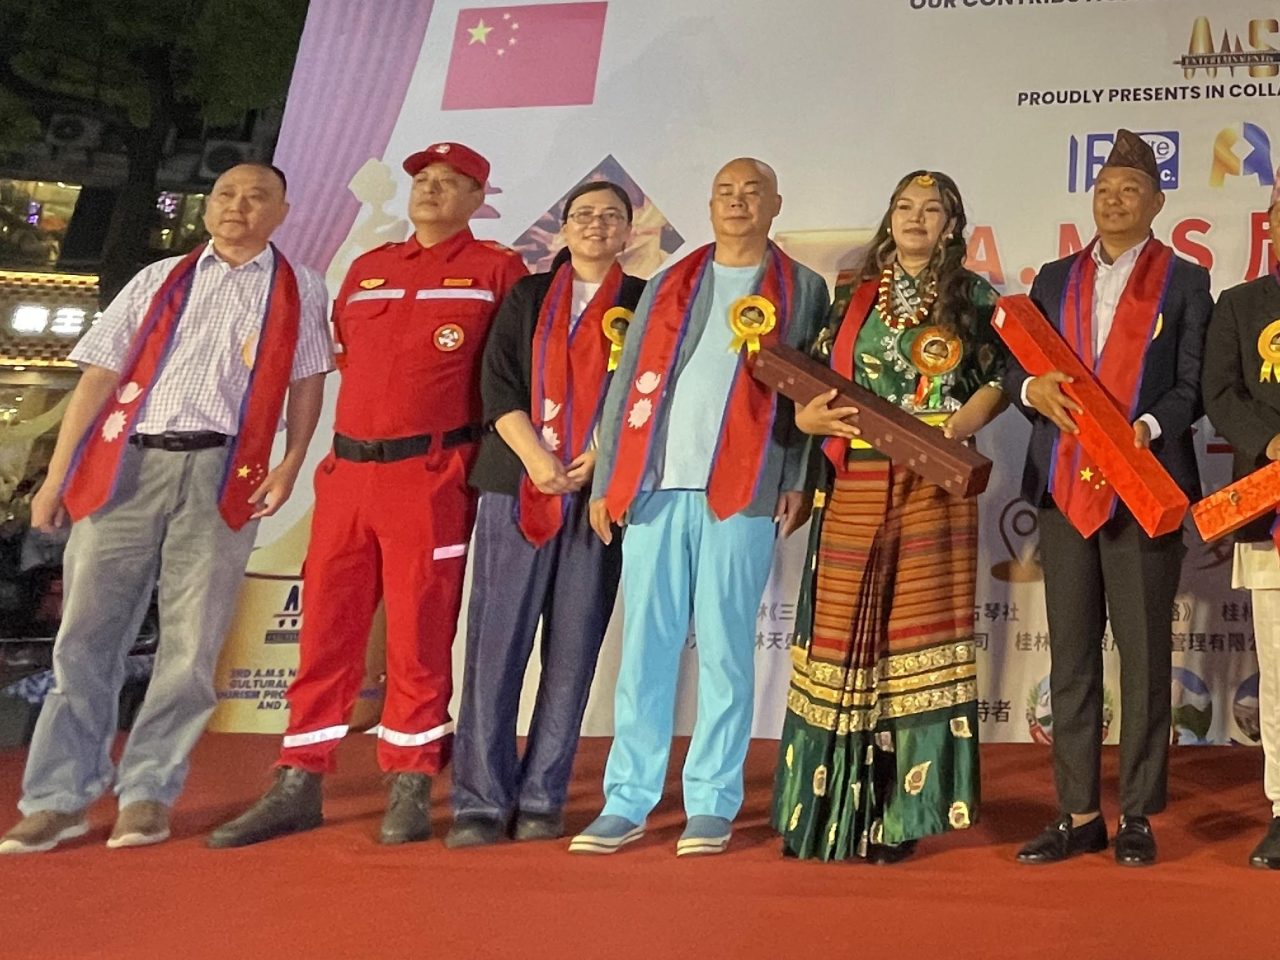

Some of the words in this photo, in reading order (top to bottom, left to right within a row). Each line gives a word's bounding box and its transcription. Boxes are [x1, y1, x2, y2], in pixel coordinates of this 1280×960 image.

[1017, 88, 1105, 106] PROUDLY
[1108, 85, 1201, 104] PRESENTS
[1205, 84, 1226, 99] IN
[963, 218, 1214, 286] A.S
